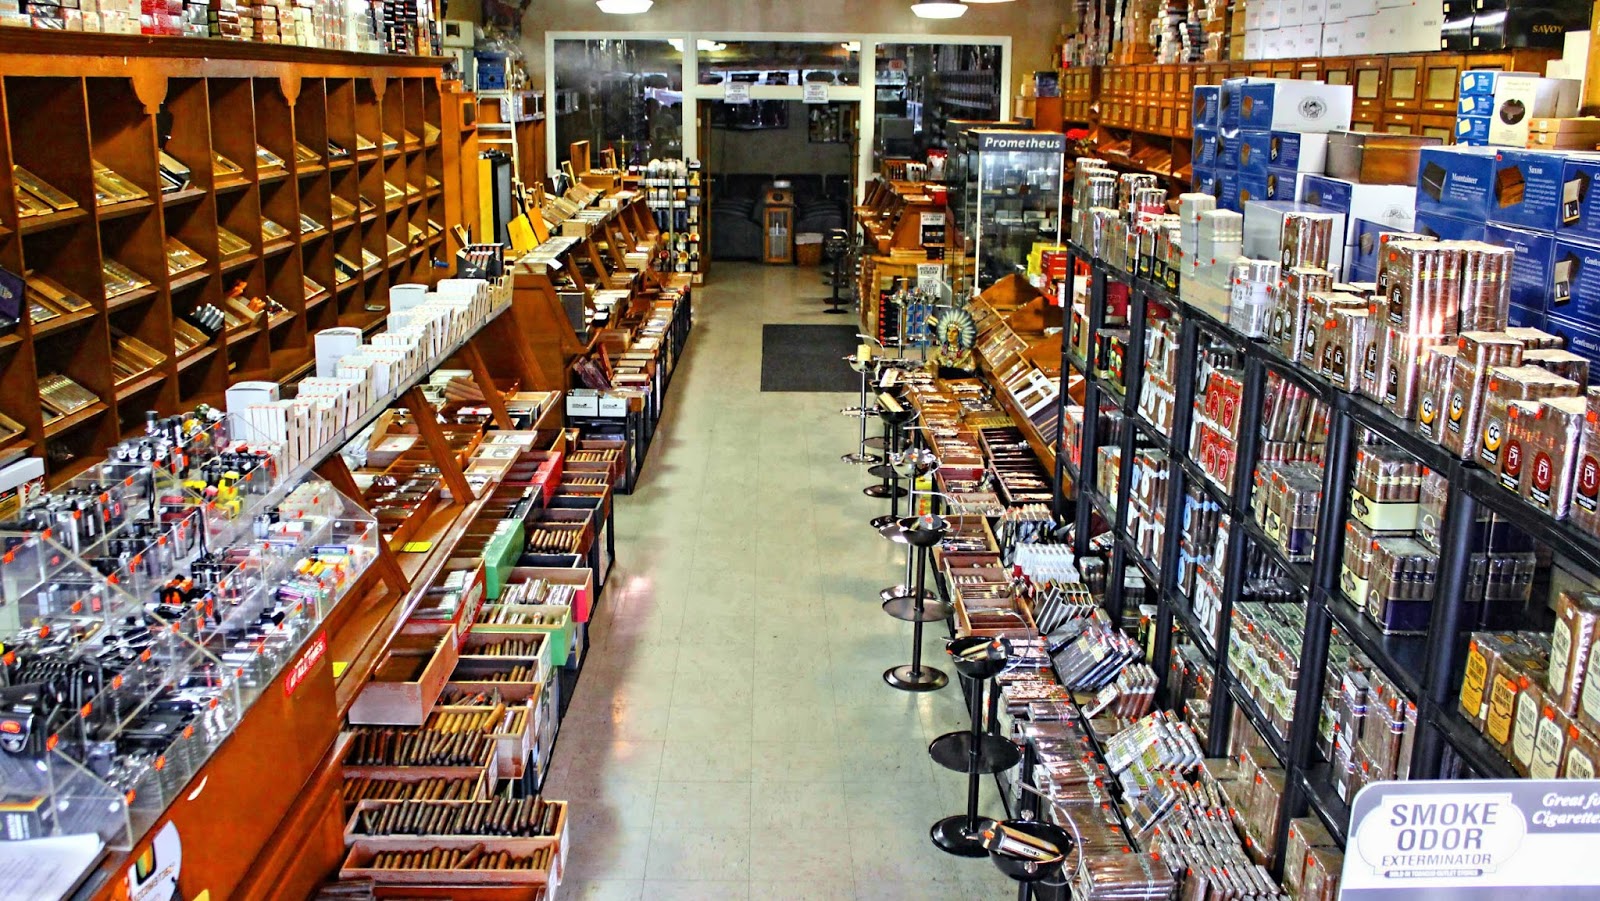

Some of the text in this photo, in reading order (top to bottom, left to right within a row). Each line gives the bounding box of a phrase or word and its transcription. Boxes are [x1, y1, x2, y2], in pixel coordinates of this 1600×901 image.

[1532, 25, 1564, 35] SAVOY
[984, 137, 1061, 149] Prometheus
[1542, 792, 1585, 807] Great
[1390, 802, 1499, 827] SMOKE
[1532, 809, 1600, 828] Cigarette
[1397, 827, 1483, 851] ODOR
[1381, 853, 1492, 867] EXTERMINATOR
